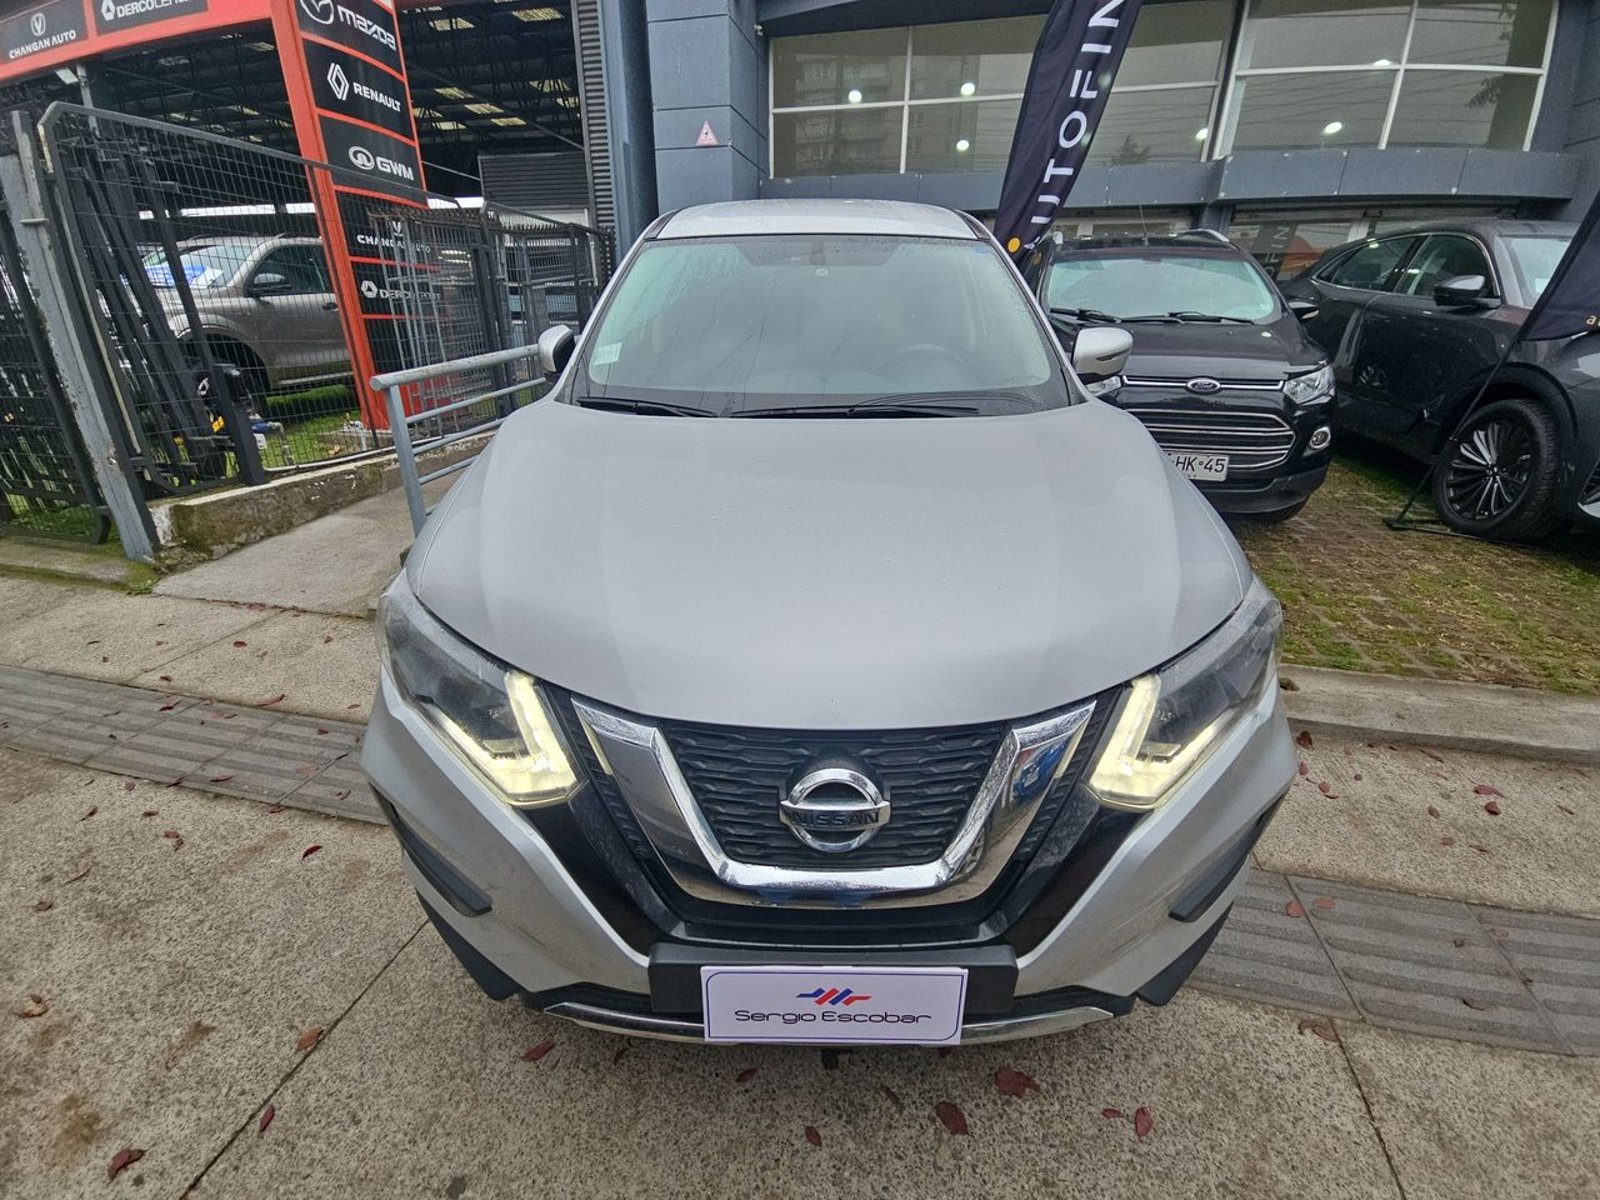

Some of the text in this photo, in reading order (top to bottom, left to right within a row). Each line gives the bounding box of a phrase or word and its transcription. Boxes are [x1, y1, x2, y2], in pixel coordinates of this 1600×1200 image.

[337, 5, 397, 51] mazda
[9, 29, 77, 59] CHANGAN AUTO
[353, 82, 401, 112] RENAULT
[376, 156, 414, 181] GWM
[791, 811, 880, 827] NISSAN
[734, 1010, 932, 1025] Sergio Escobar
